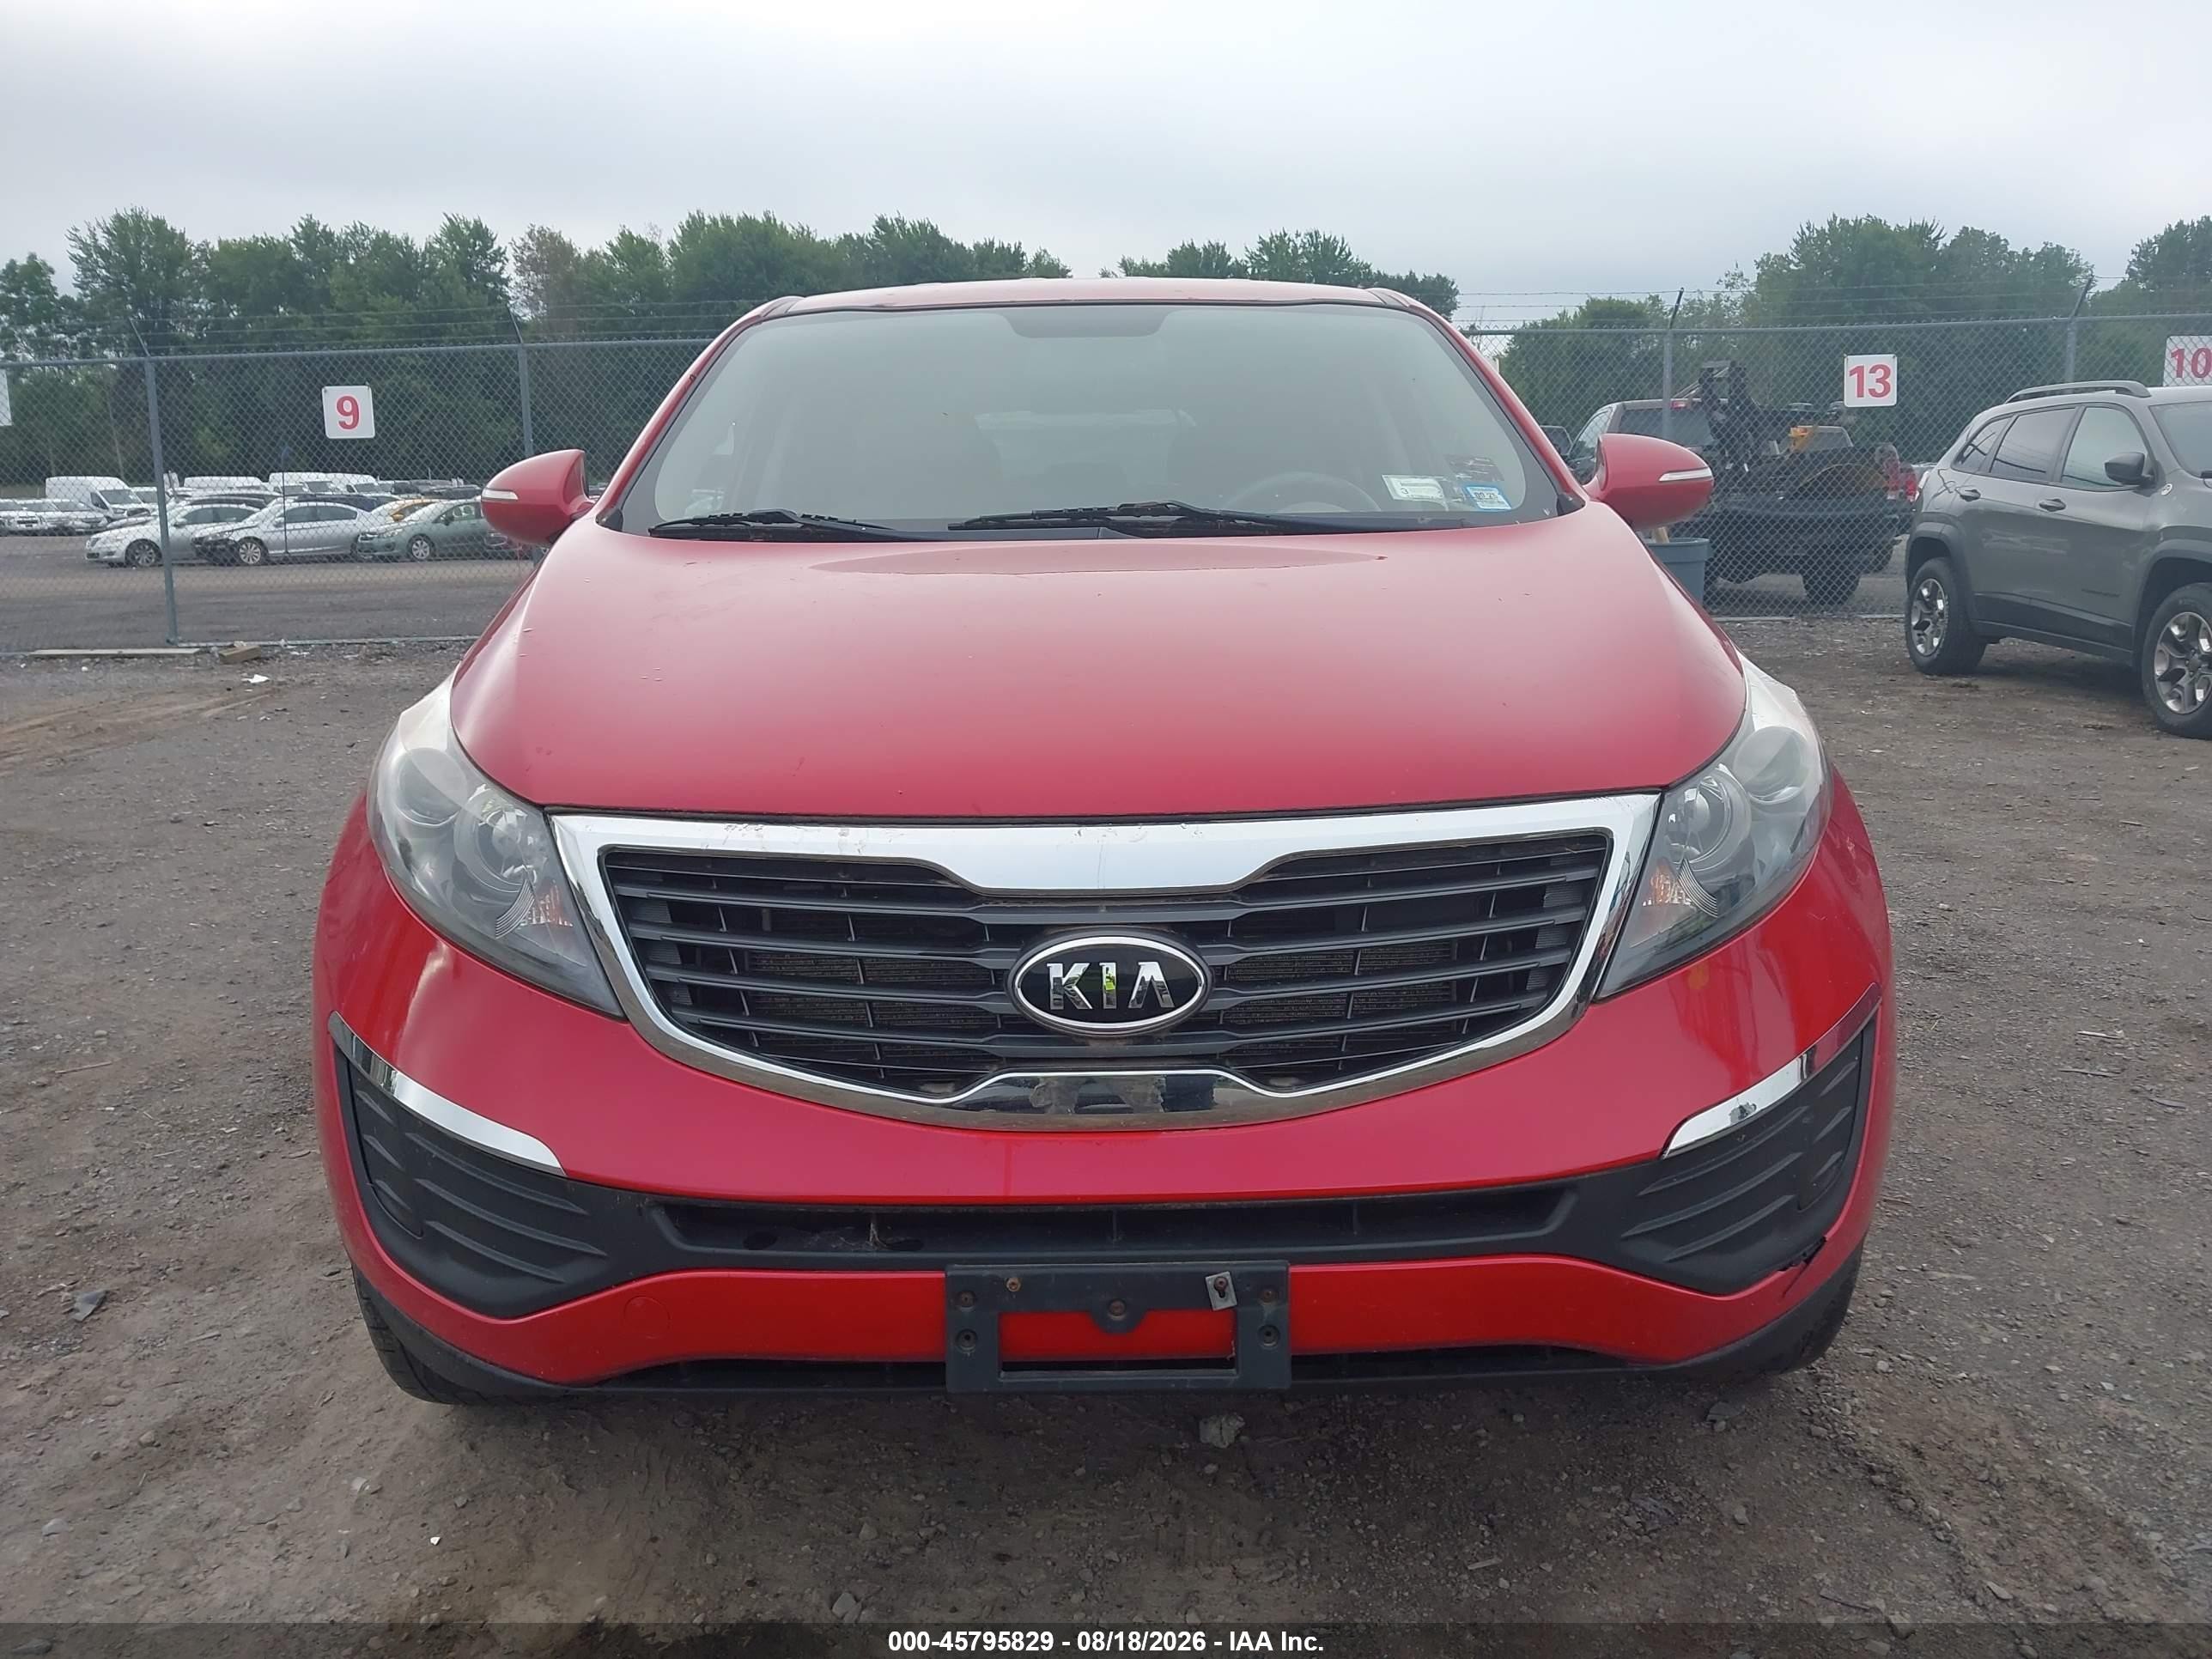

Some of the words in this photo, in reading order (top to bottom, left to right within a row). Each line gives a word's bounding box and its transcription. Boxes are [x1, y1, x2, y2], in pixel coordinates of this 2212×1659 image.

[2171, 348, 2212, 378] 10
[1849, 364, 1891, 398] 13
[337, 396, 360, 429] 9
[1046, 961, 1176, 1011] KIA
